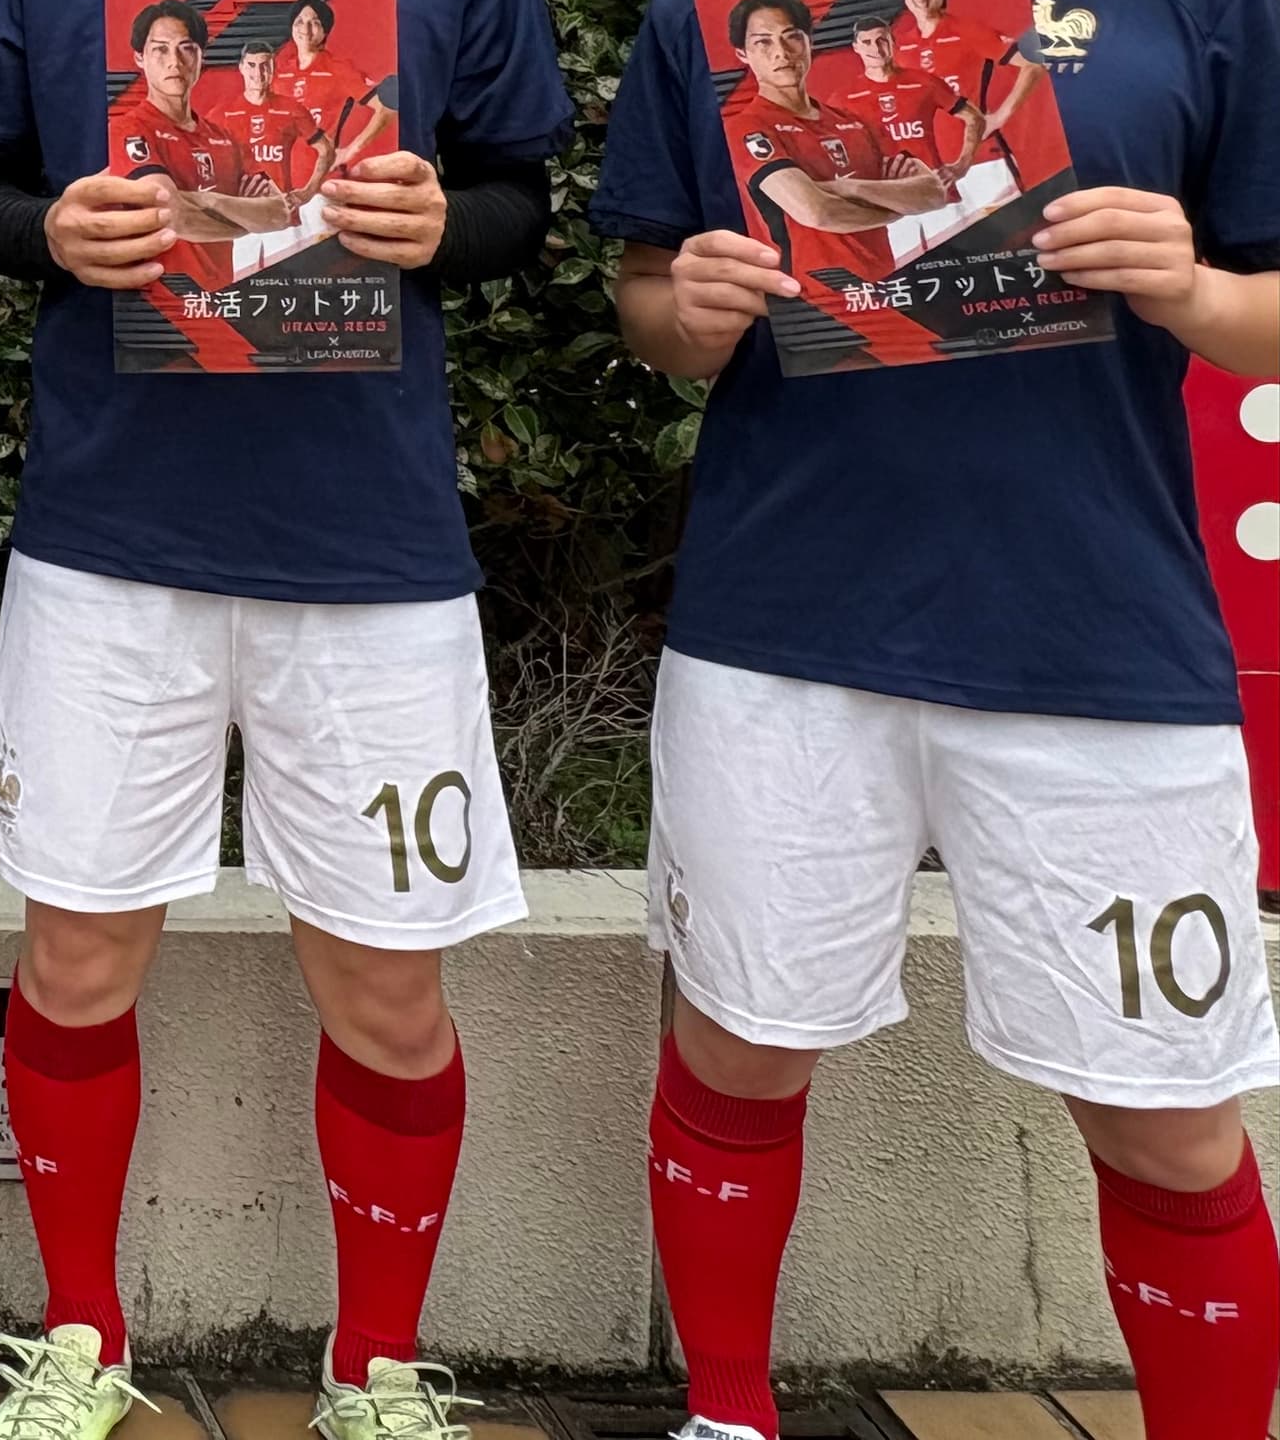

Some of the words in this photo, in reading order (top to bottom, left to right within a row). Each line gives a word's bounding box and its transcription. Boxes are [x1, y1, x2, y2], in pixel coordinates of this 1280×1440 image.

[182, 289, 393, 319] 就活フットサル
[841, 261, 1046, 313] 就活フットサ
[960, 295, 1031, 316] URAWA
[1037, 289, 1088, 306] REDS
[281, 320, 338, 334] URAWA
[344, 320, 387, 333] REDS
[361, 769, 473, 894] 10
[1085, 892, 1232, 1020] 10
